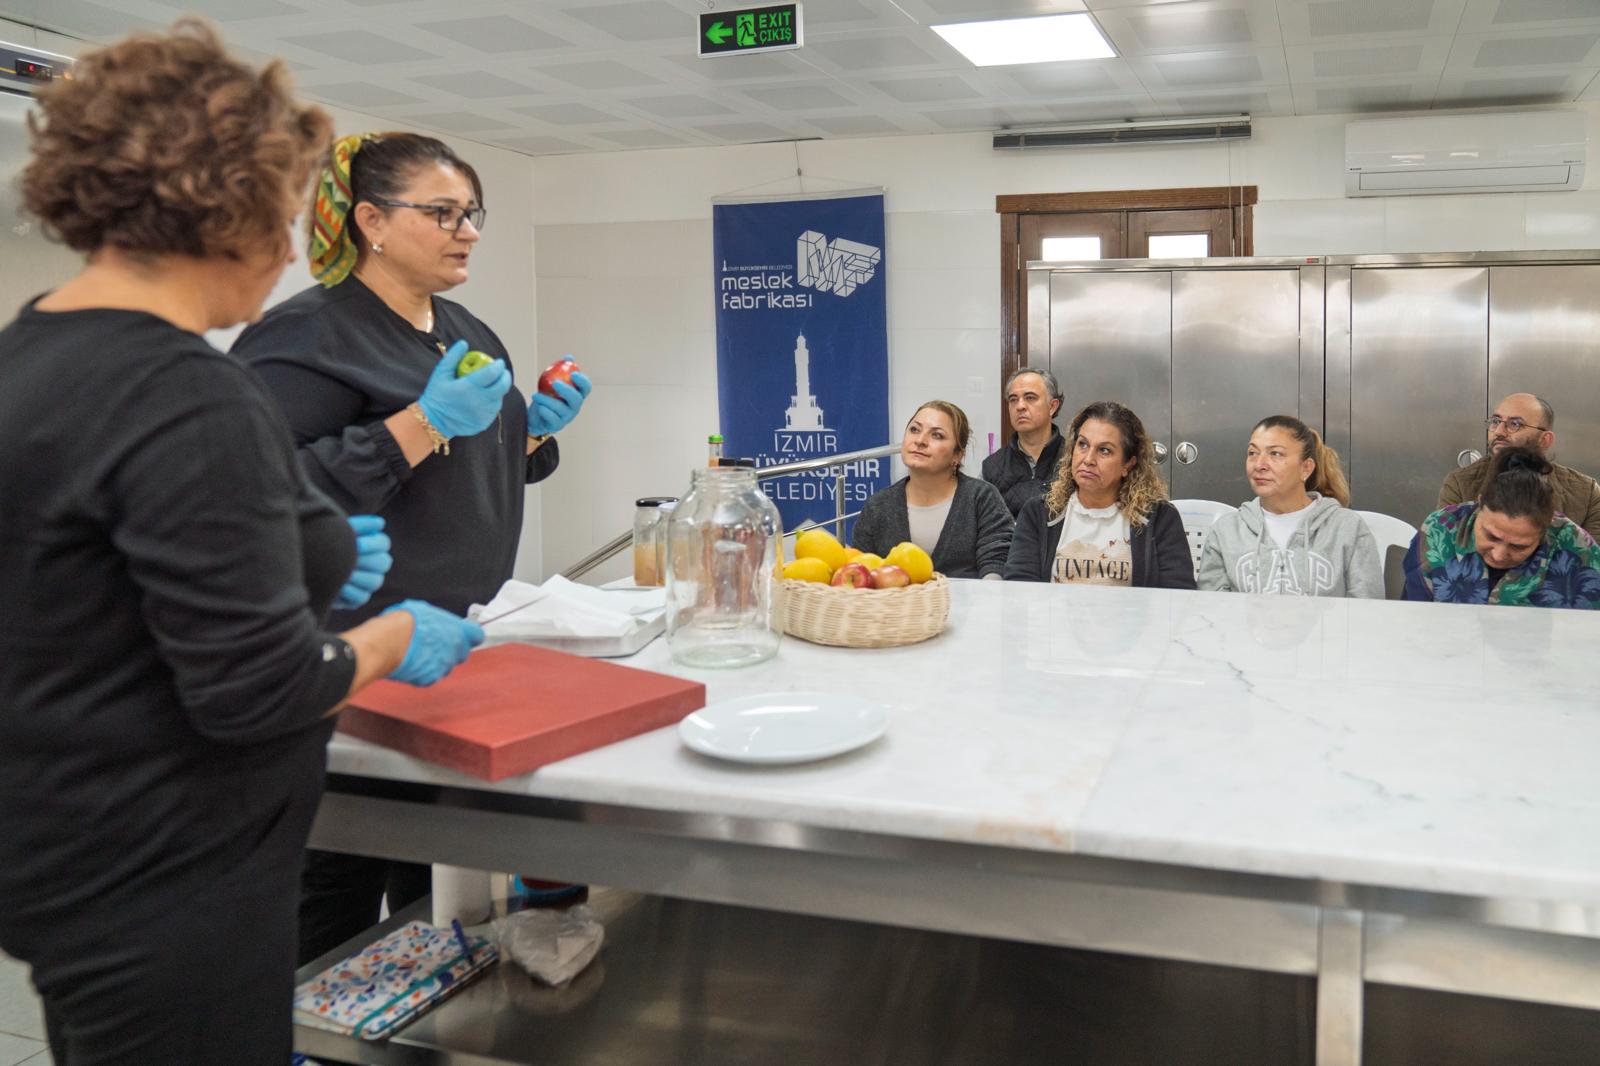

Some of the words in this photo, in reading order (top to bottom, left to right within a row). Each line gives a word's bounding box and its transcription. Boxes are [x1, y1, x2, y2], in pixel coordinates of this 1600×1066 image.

[758, 11, 792, 28] EXIT
[759, 28, 792, 44] ÇIKIŞ
[721, 271, 793, 290] meslek
[722, 291, 813, 310] fabrikası
[774, 432, 838, 453] İZMİR
[762, 481, 874, 501] ELEDİYESİ
[1235, 548, 1335, 597] GAP
